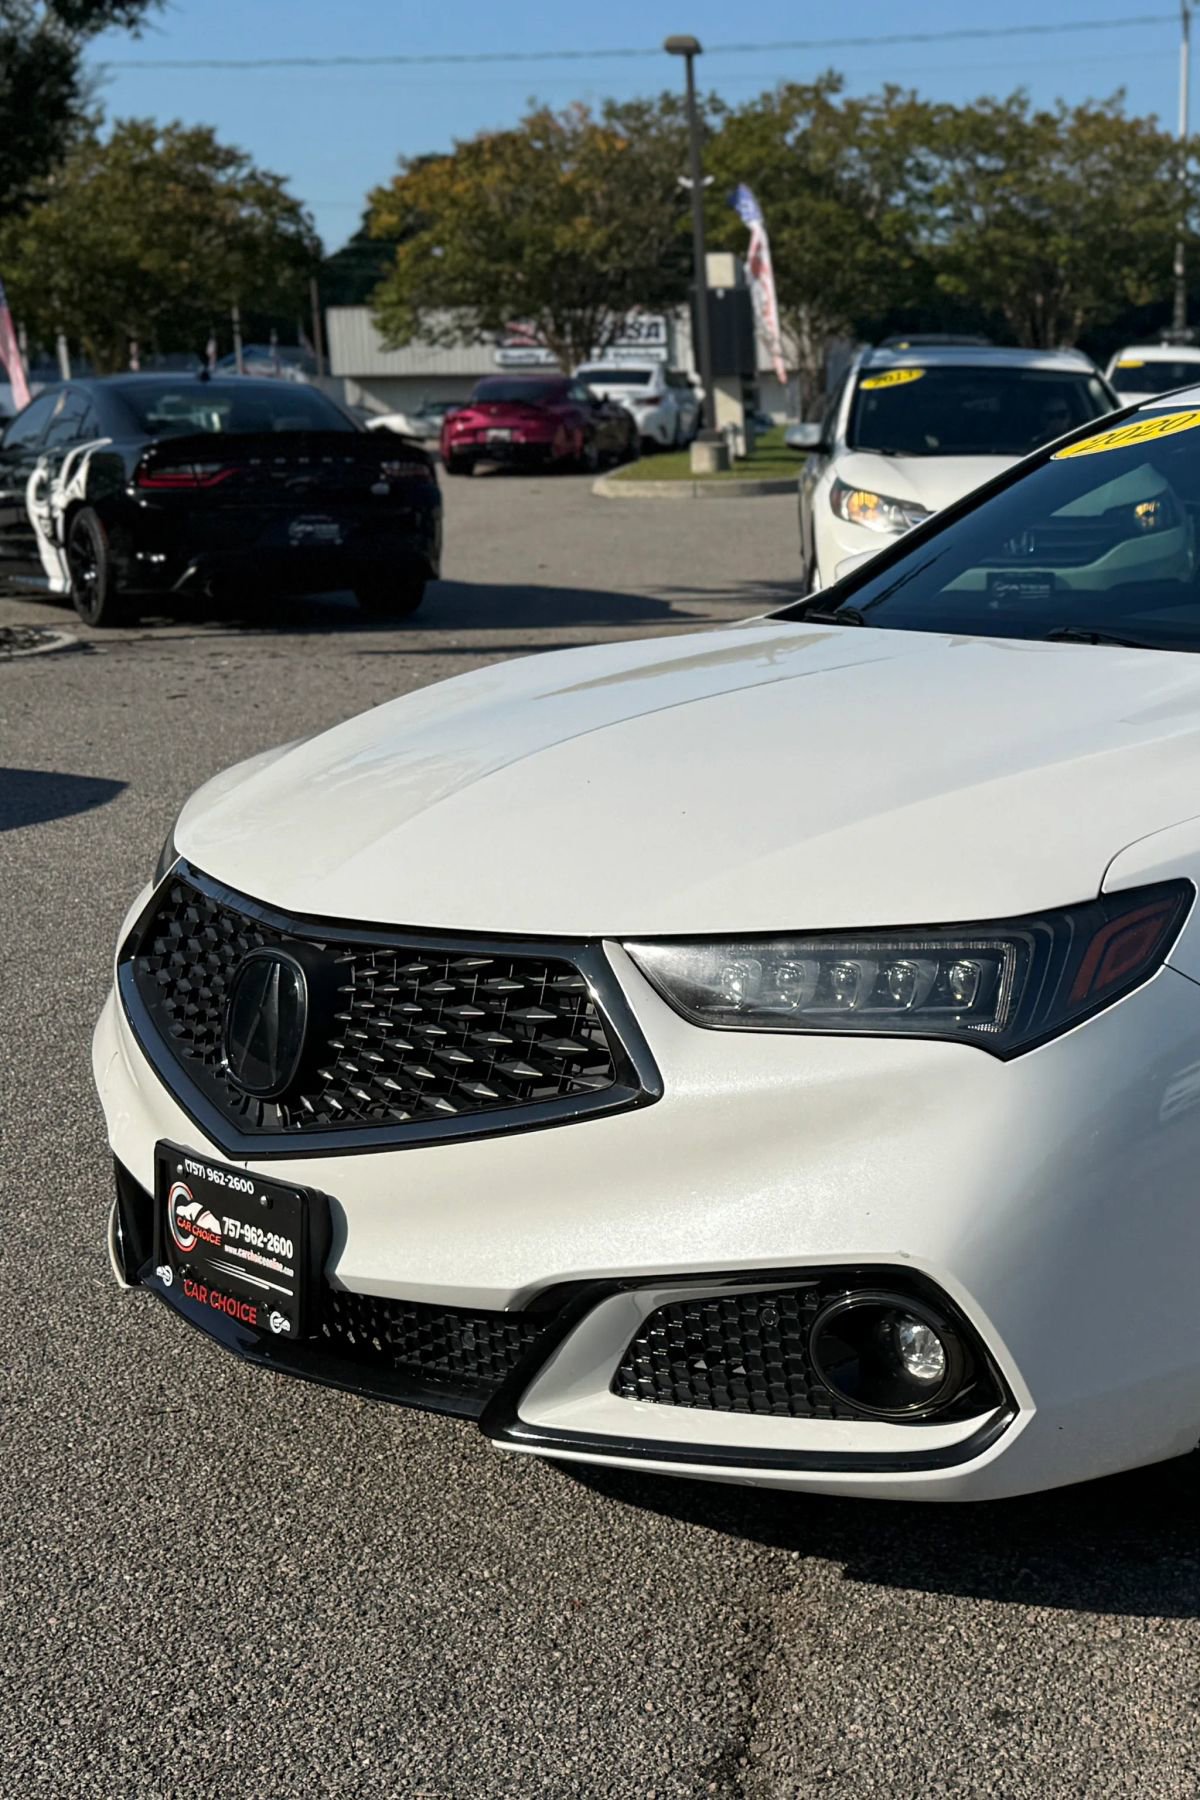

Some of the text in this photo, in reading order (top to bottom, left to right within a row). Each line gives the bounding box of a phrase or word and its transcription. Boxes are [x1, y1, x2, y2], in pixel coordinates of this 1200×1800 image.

[1072, 412, 1199, 454] 2020
[184, 1158, 255, 1195] (757) 962-2600
[177, 1217, 222, 1247] CAR CHOICE
[222, 1216, 294, 1260] 757-962-2600
[184, 1279, 257, 1325] CAR CHOICE
